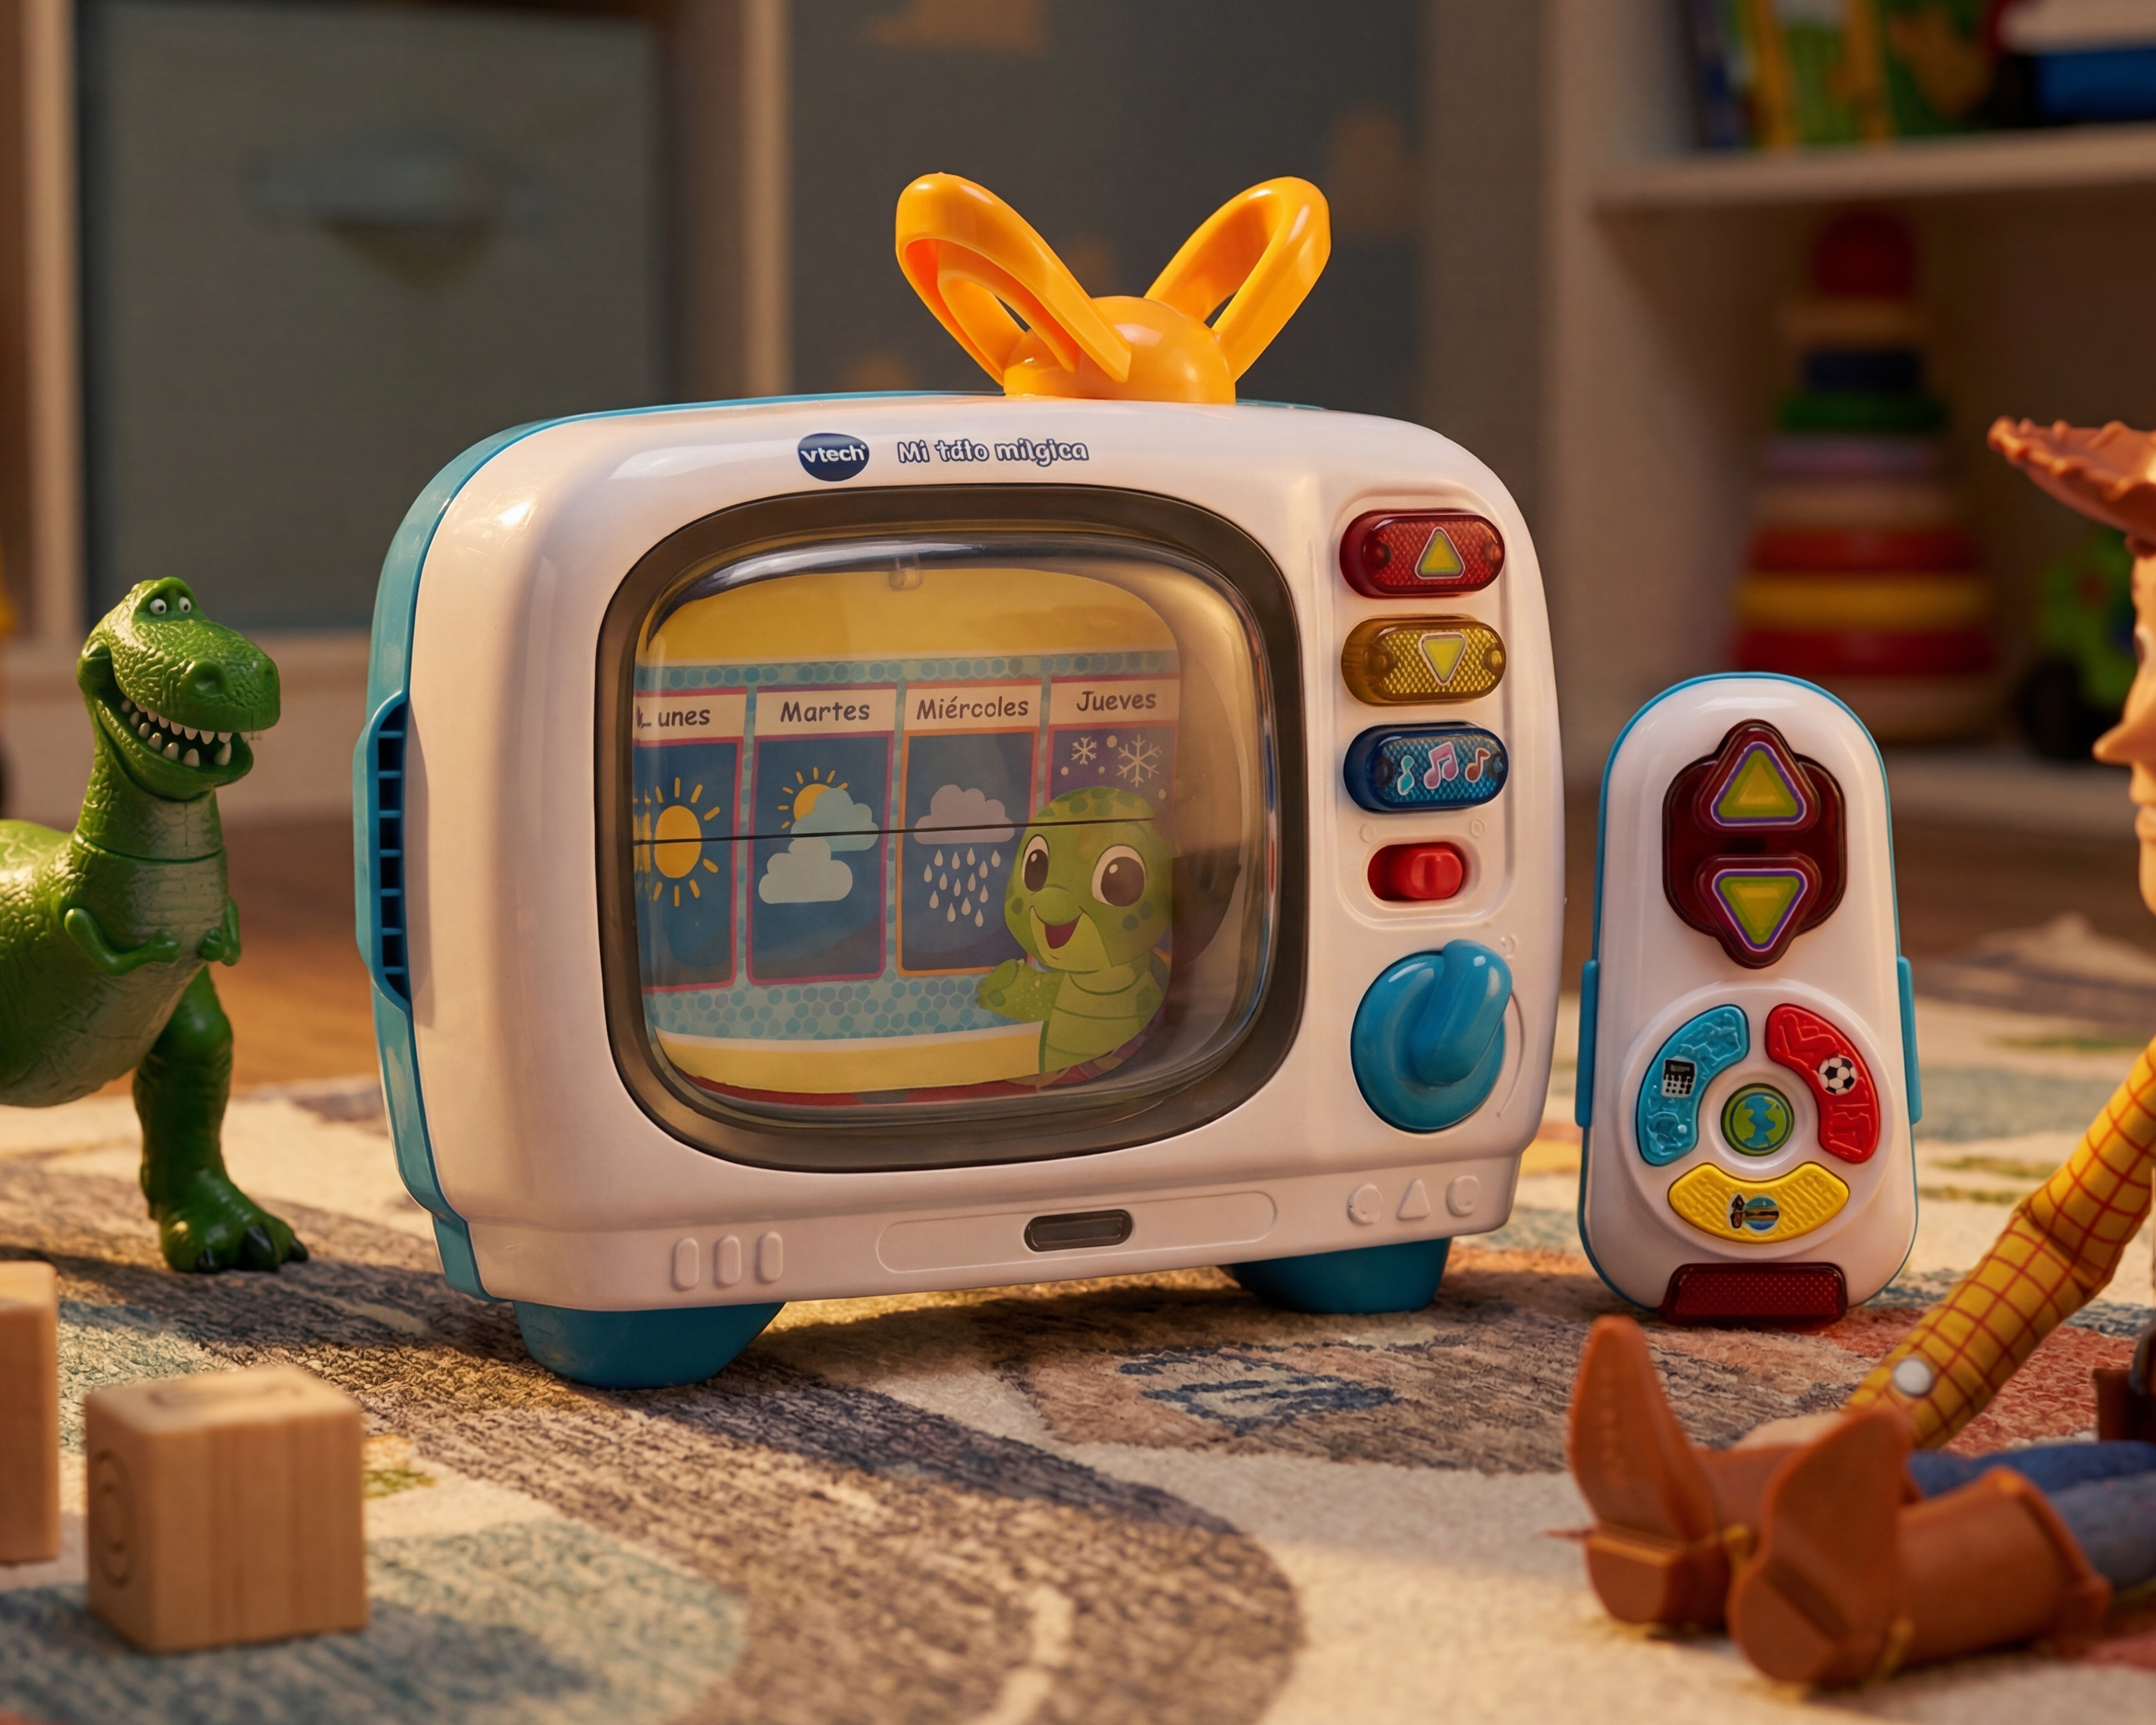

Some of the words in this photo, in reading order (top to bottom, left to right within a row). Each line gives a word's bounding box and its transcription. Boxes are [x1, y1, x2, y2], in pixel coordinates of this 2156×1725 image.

[800, 444, 865, 463] vtech
[897, 439, 930, 463] Mi
[780, 701, 870, 723] Martes
[916, 695, 1029, 720] Miércoles
[1076, 690, 1157, 712] Jueves
